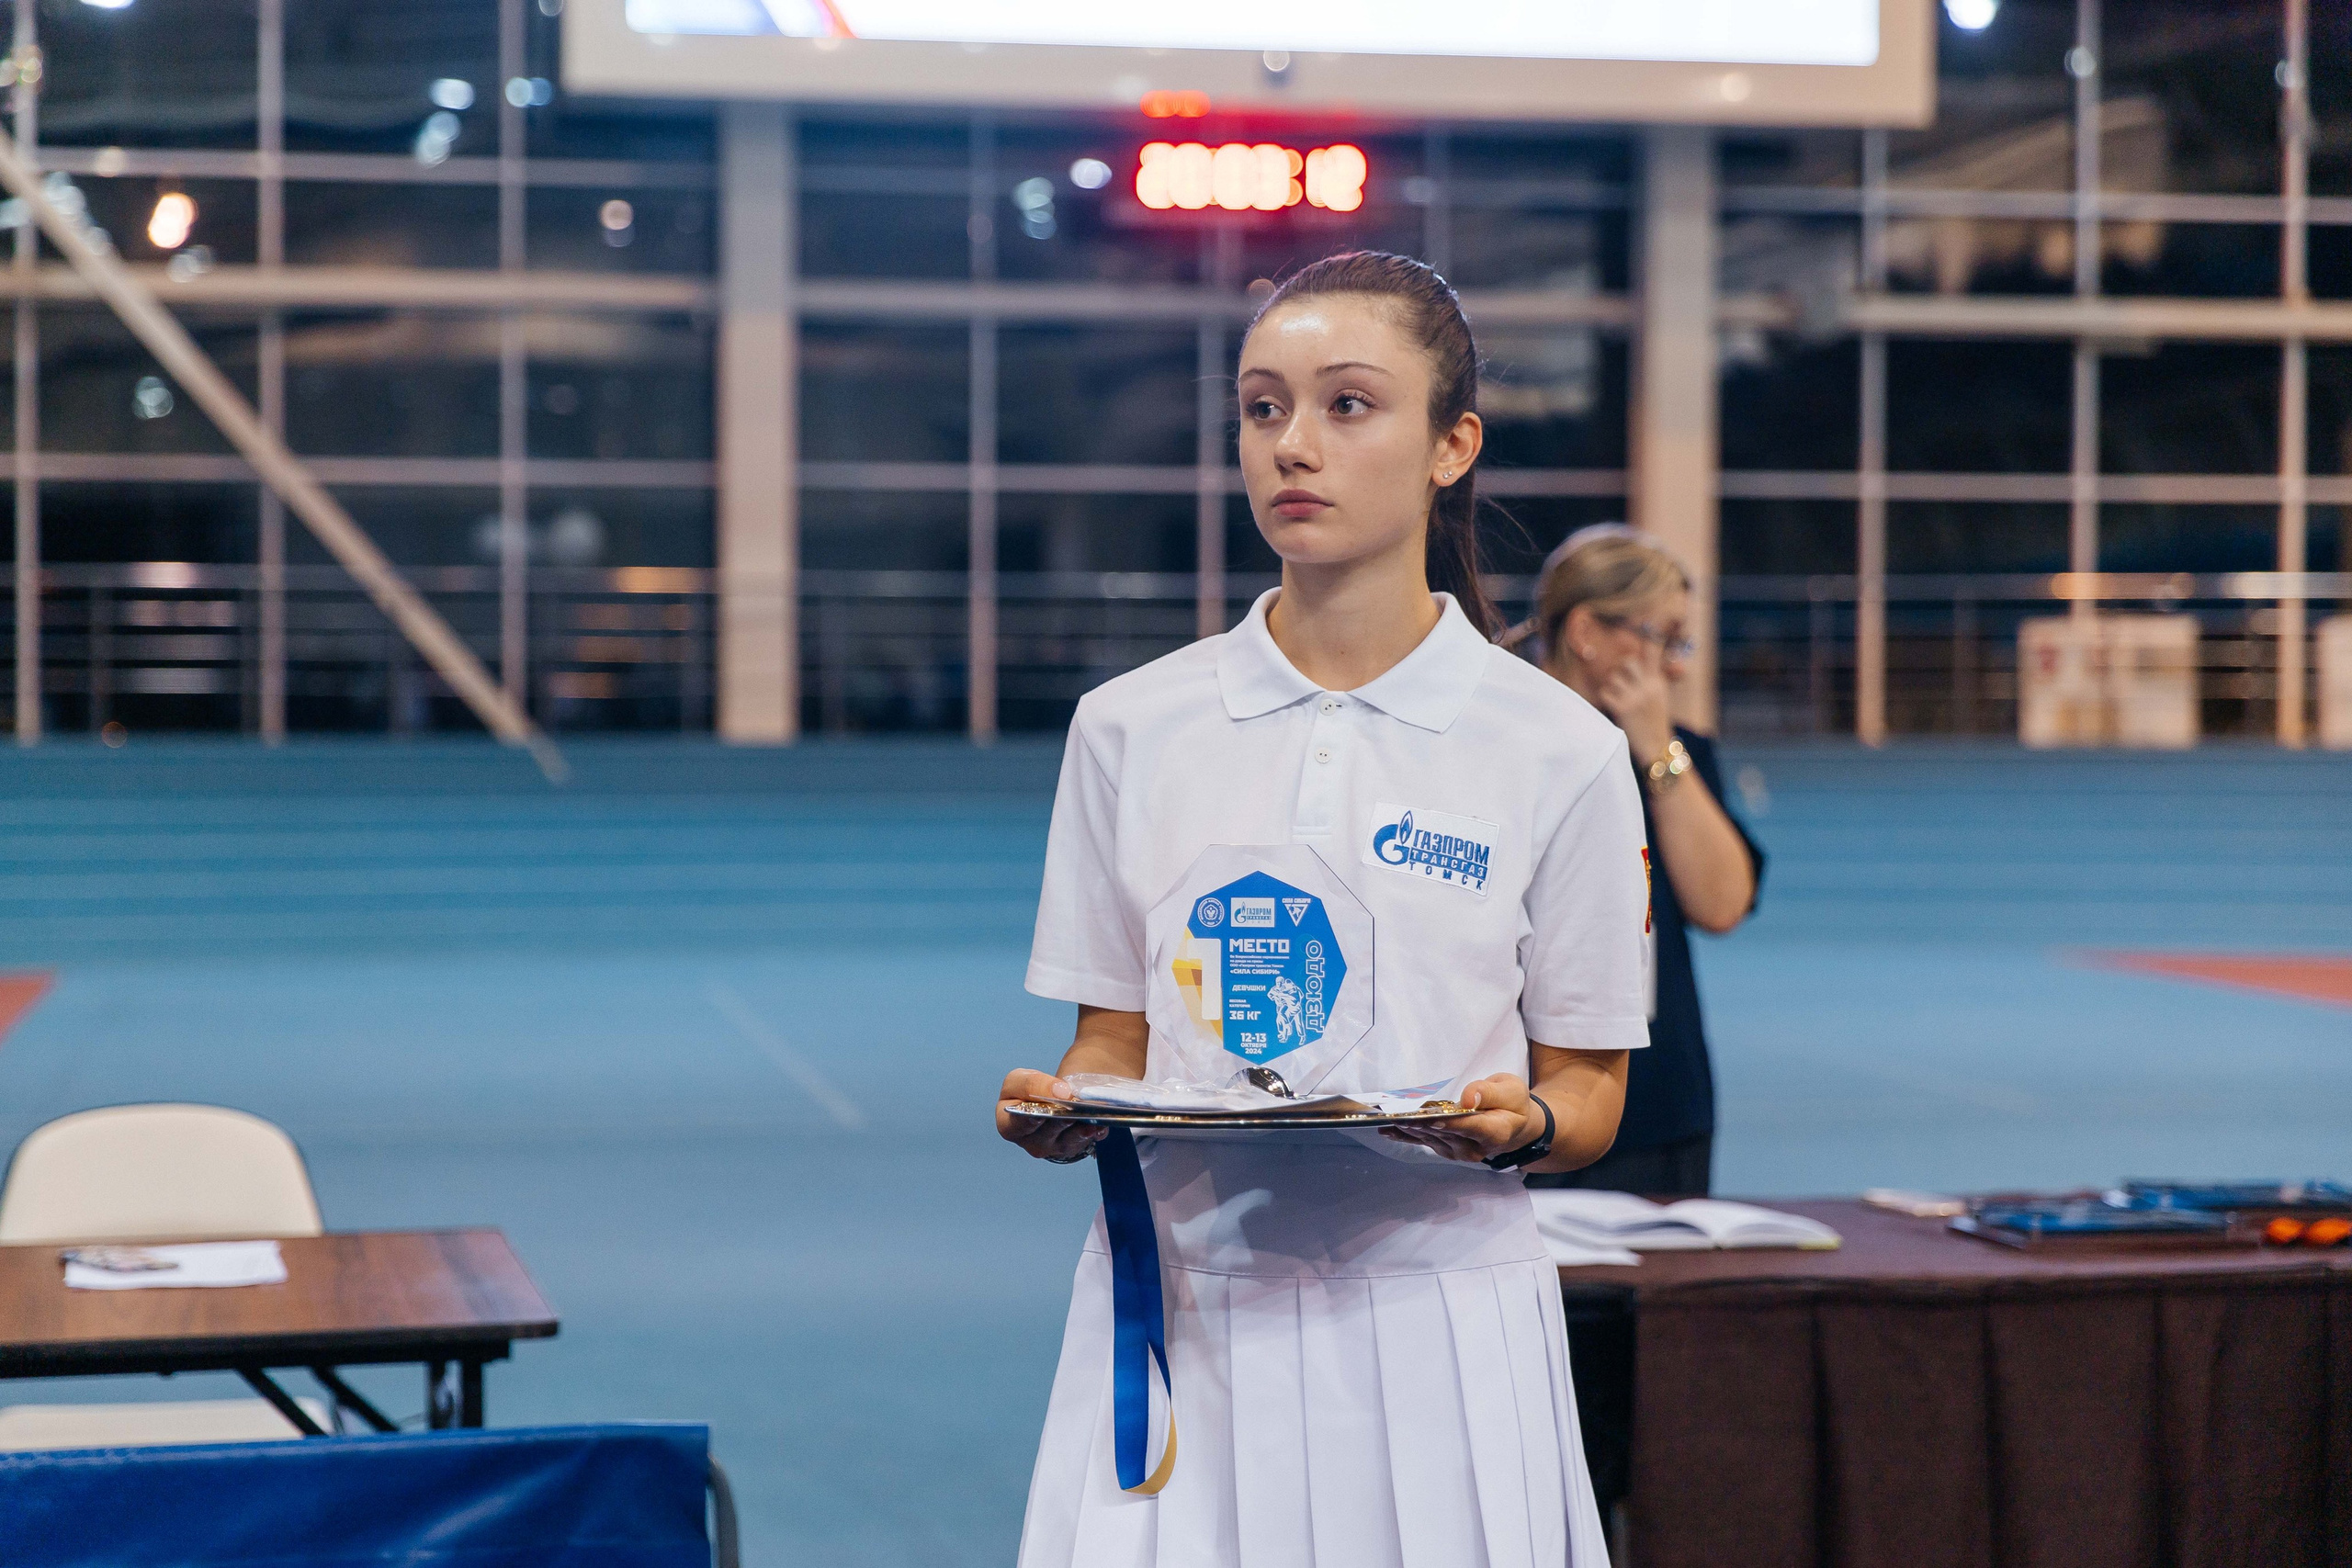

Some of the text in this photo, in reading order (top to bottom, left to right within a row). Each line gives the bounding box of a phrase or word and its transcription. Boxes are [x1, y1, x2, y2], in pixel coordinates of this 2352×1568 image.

[1413, 829, 1489, 865] ГАЗПРОМ
[1411, 849, 1486, 878] ТРАНСГАЗ
[1408, 861, 1483, 890] ТОМСК
[1229, 938, 1290, 953] МЕСТО
[1231, 984, 1266, 992] ДЕВУШКИ
[1306, 940, 1326, 1033] ДЗЮДО
[1229, 1010, 1261, 1021] 36 КГ
[1240, 1032, 1267, 1043] 12-13
